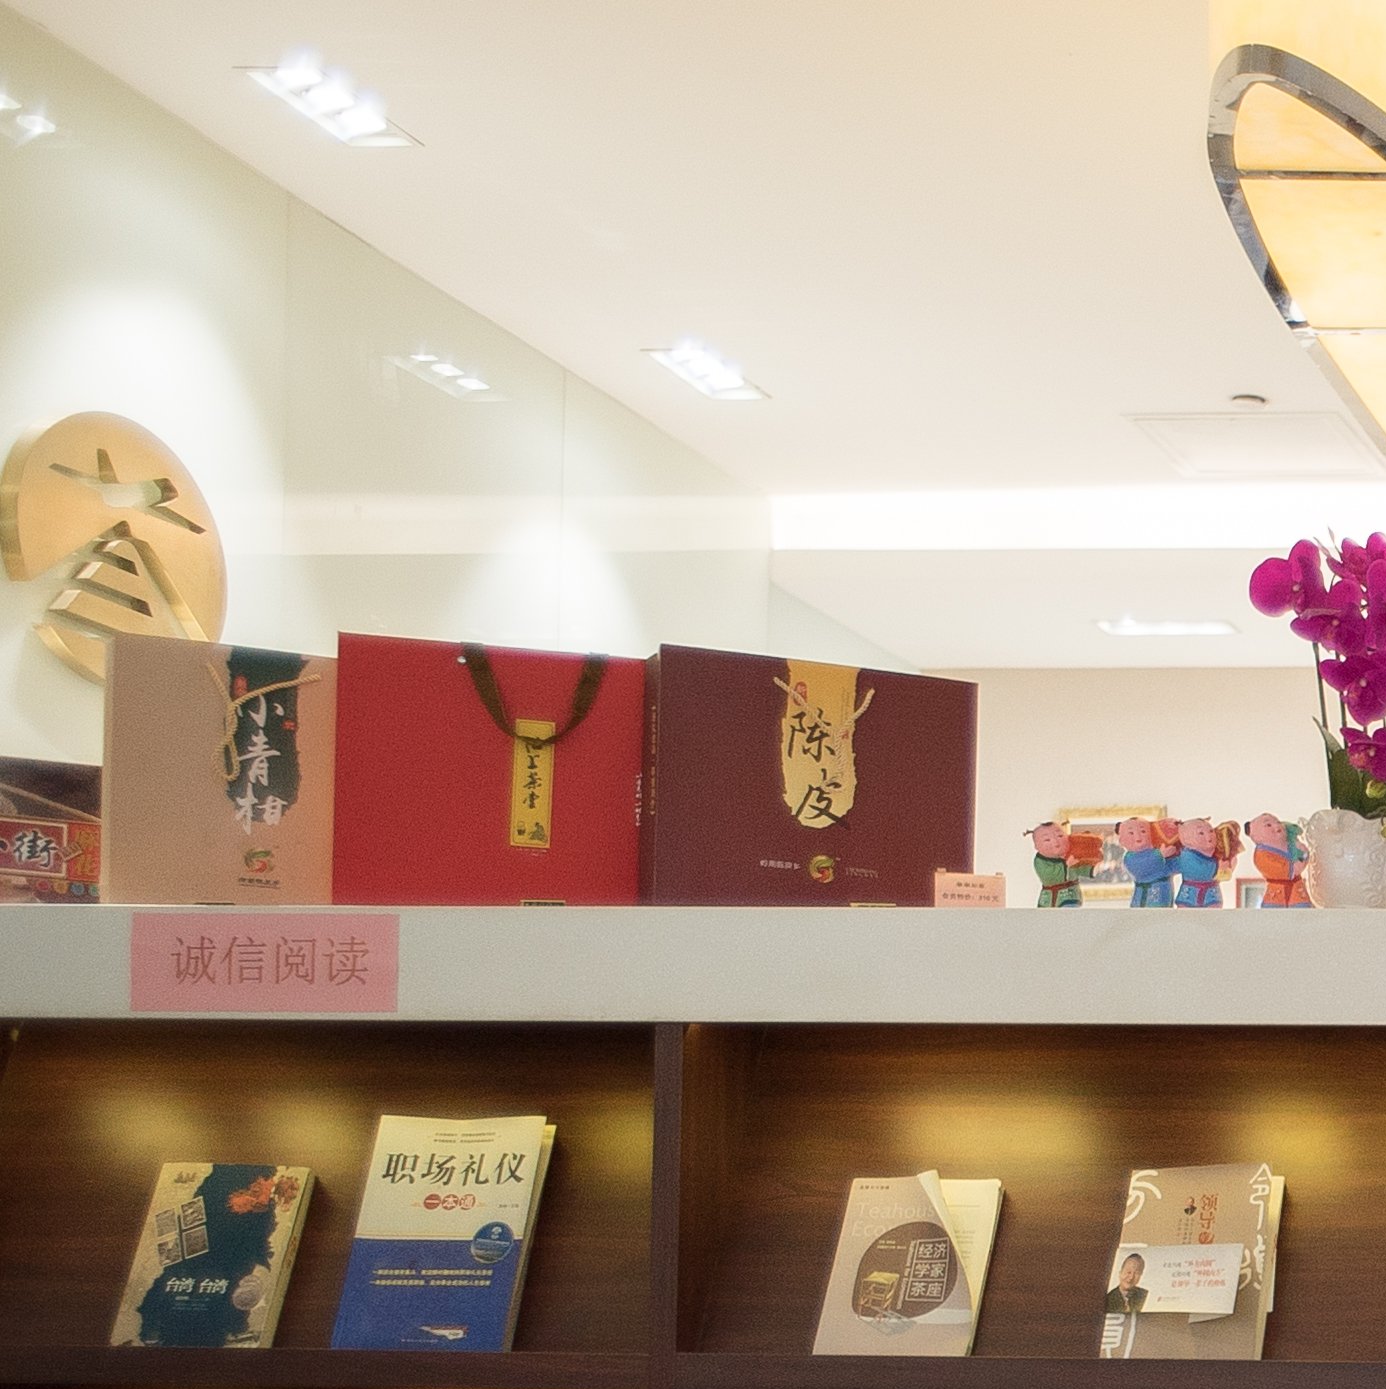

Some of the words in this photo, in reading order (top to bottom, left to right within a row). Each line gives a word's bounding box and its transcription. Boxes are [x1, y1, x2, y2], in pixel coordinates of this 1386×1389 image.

[788, 707, 850, 830] 陈皮
[170, 935, 370, 986] 诚信阅读
[381, 1152, 526, 1187] 职场礼仪
[424, 1193, 476, 1211] 一本通
[917, 1241, 948, 1260] 经济
[914, 1261, 945, 1279] 学家
[165, 1276, 195, 1293] 台湾
[199, 1277, 230, 1294] 台湾
[910, 1281, 943, 1299] 茶座
